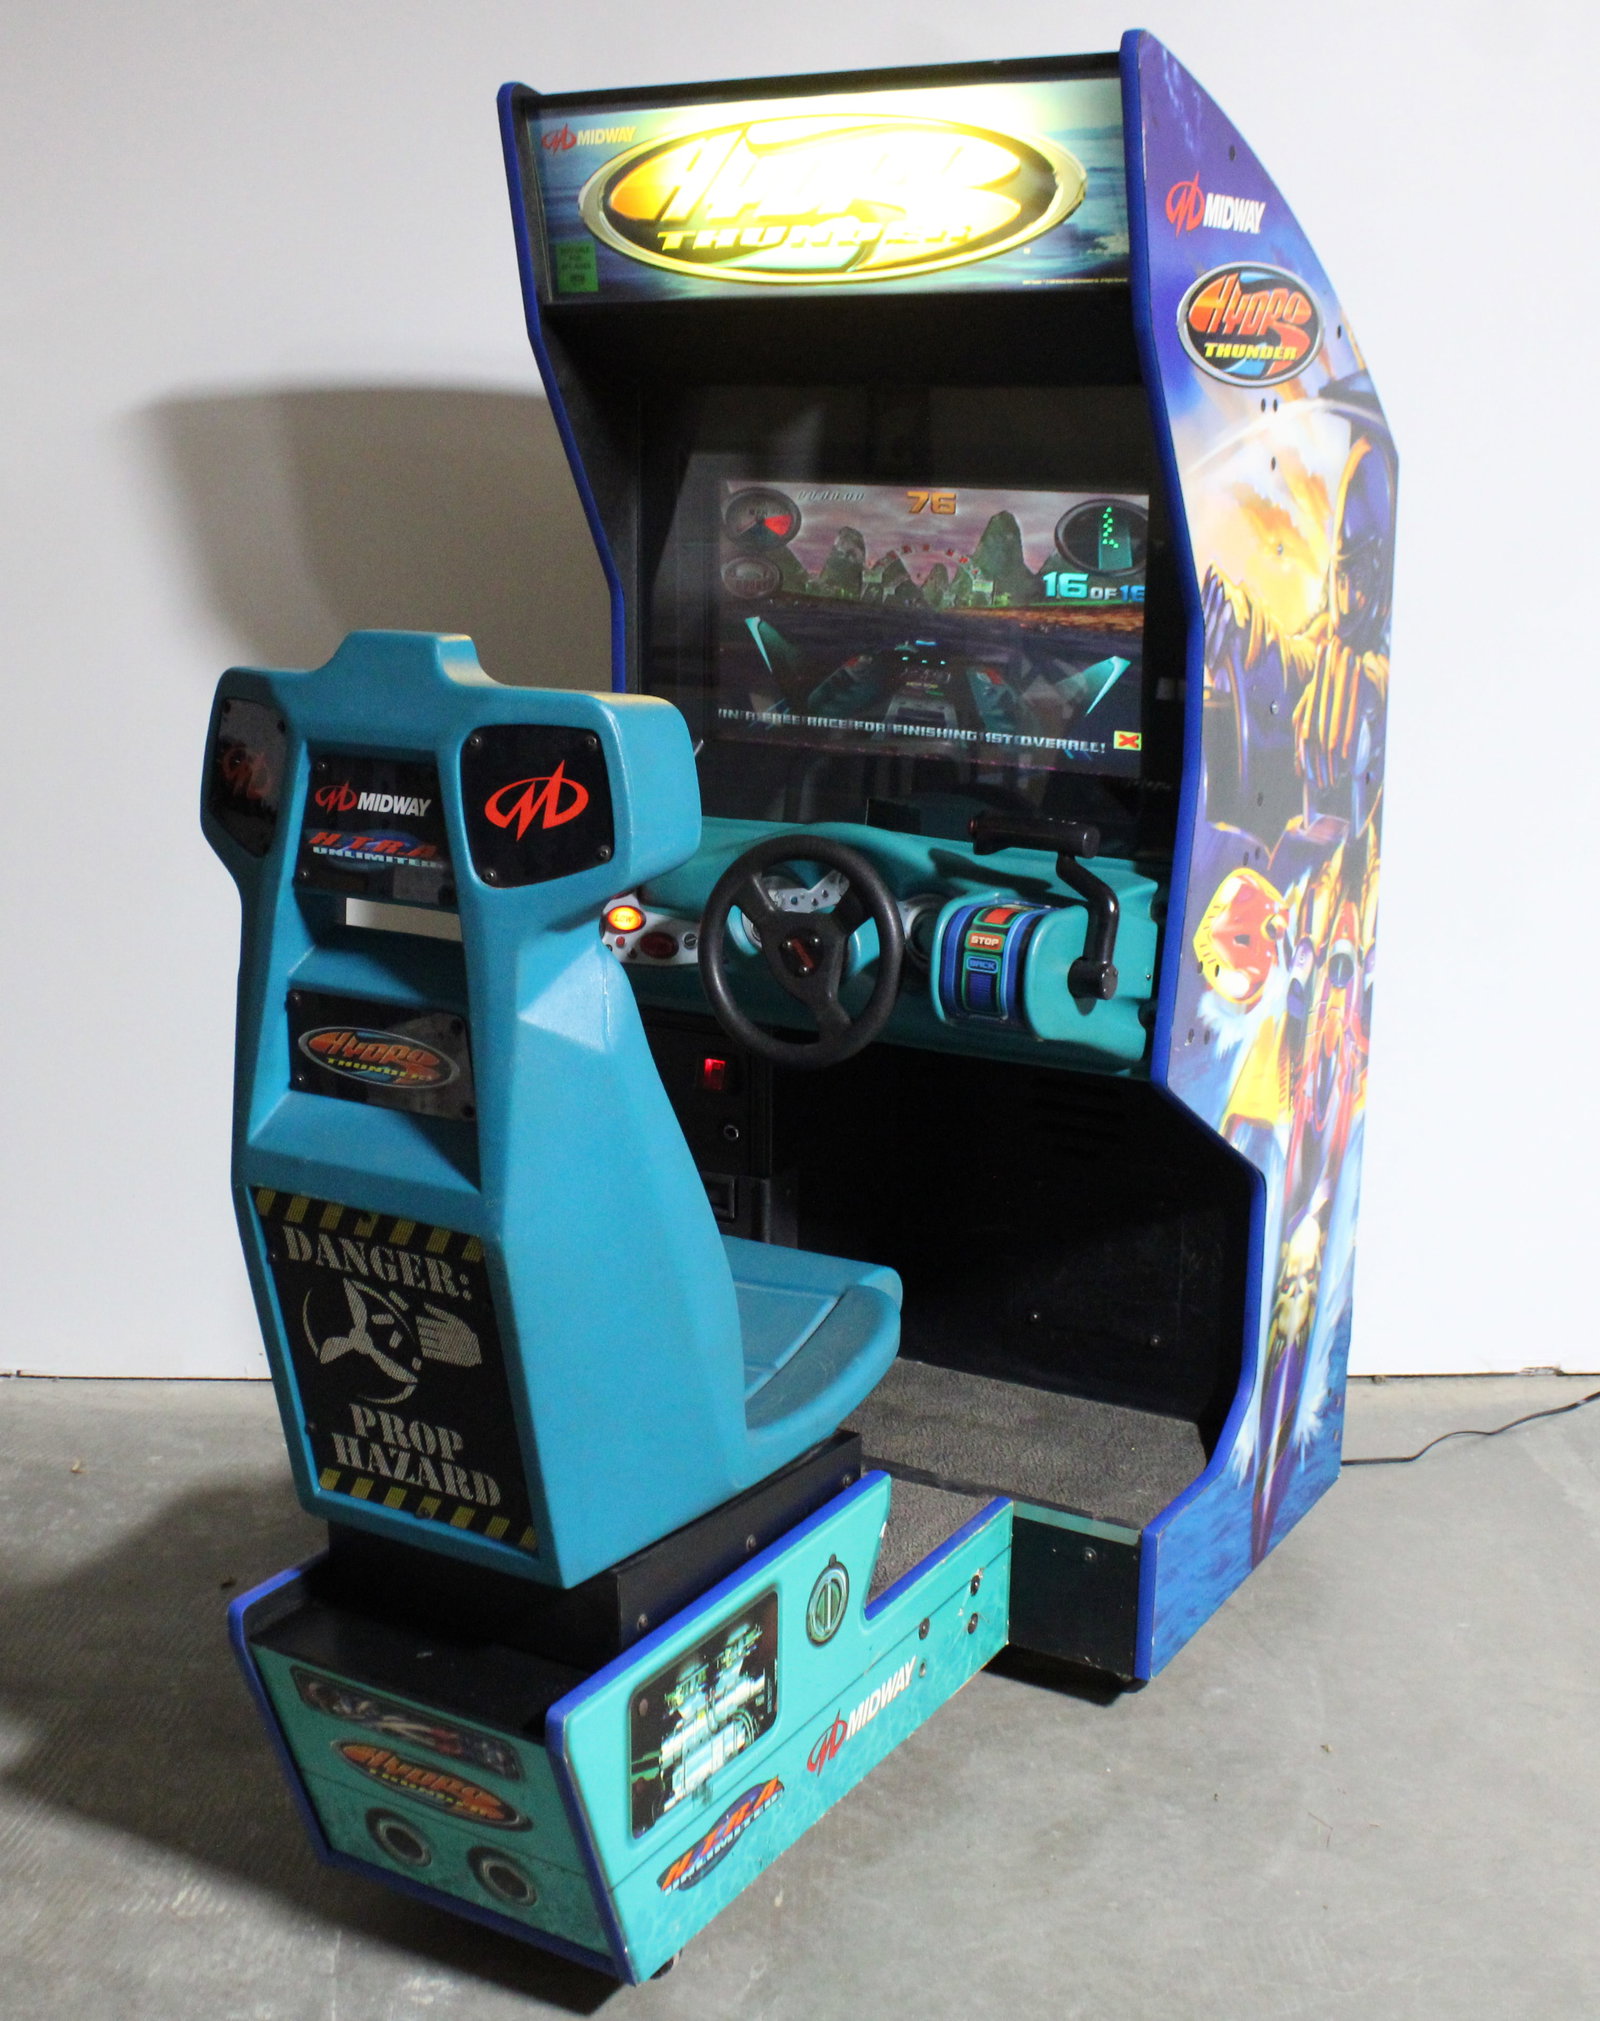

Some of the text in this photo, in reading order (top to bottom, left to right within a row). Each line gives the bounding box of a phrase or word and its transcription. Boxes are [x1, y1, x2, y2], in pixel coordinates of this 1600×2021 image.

[577, 126, 637, 146] MIDWAY
[1203, 193, 1266, 234] MIDWAY
[1204, 342, 1297, 361] THUNDER
[906, 491, 957, 515] 76
[1043, 571, 1089, 598] 16
[1090, 586, 1117, 600] OF
[807, 716, 848, 729] RACE
[854, 720, 886, 733] FOR
[893, 724, 977, 741] FINISHING
[984, 732, 1013, 745] 1ST
[357, 792, 432, 817] MIDWAY
[971, 935, 999, 946] STOP
[969, 959, 995, 970] BACK
[282, 1225, 472, 1301] DANGER:
[350, 1403, 464, 1461] PROP
[332, 1432, 500, 1507] HAZARD
[846, 1654, 917, 1741] MIDWAY
